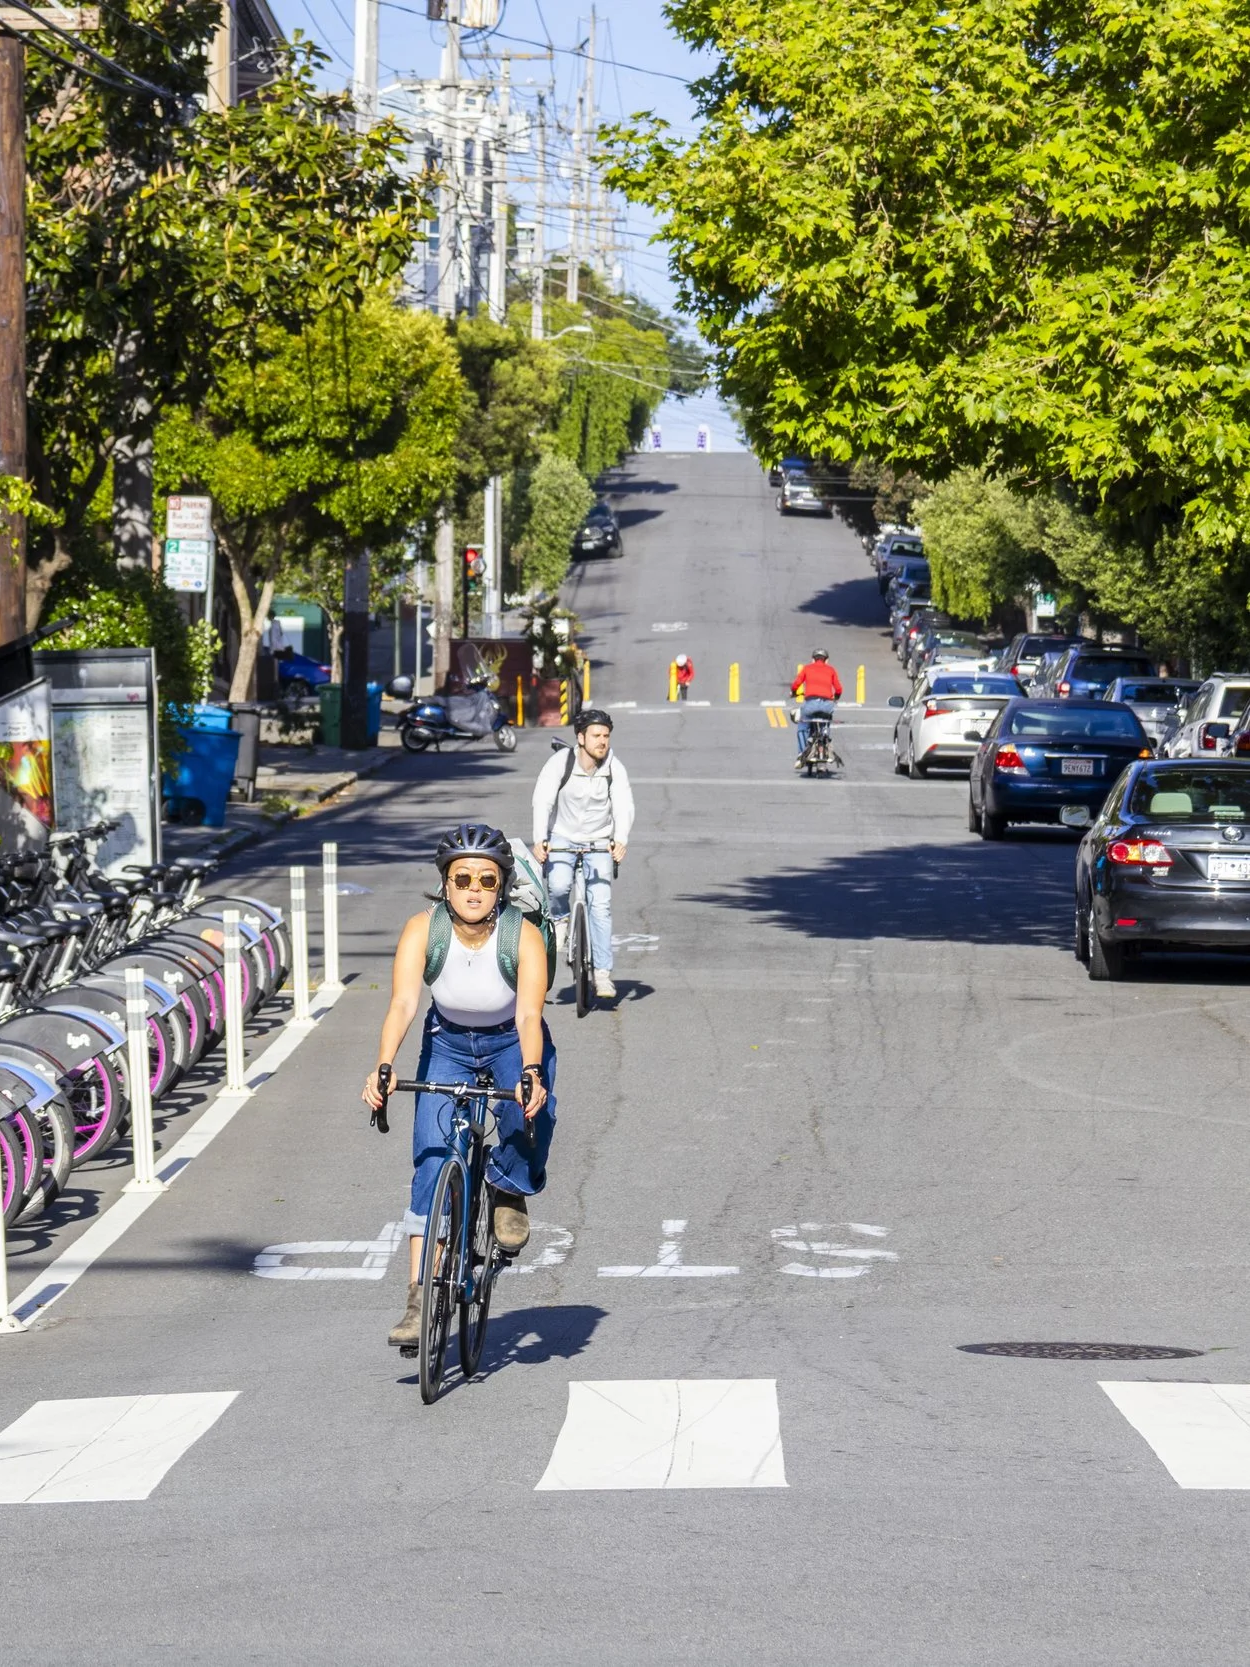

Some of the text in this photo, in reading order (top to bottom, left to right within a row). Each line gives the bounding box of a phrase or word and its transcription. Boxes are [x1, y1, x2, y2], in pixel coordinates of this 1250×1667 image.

[169, 542, 178, 552] 2
[163, 970, 183, 984] lyft
[66, 1032, 91, 1050] lyft
[251, 1217, 900, 1280] STOP
